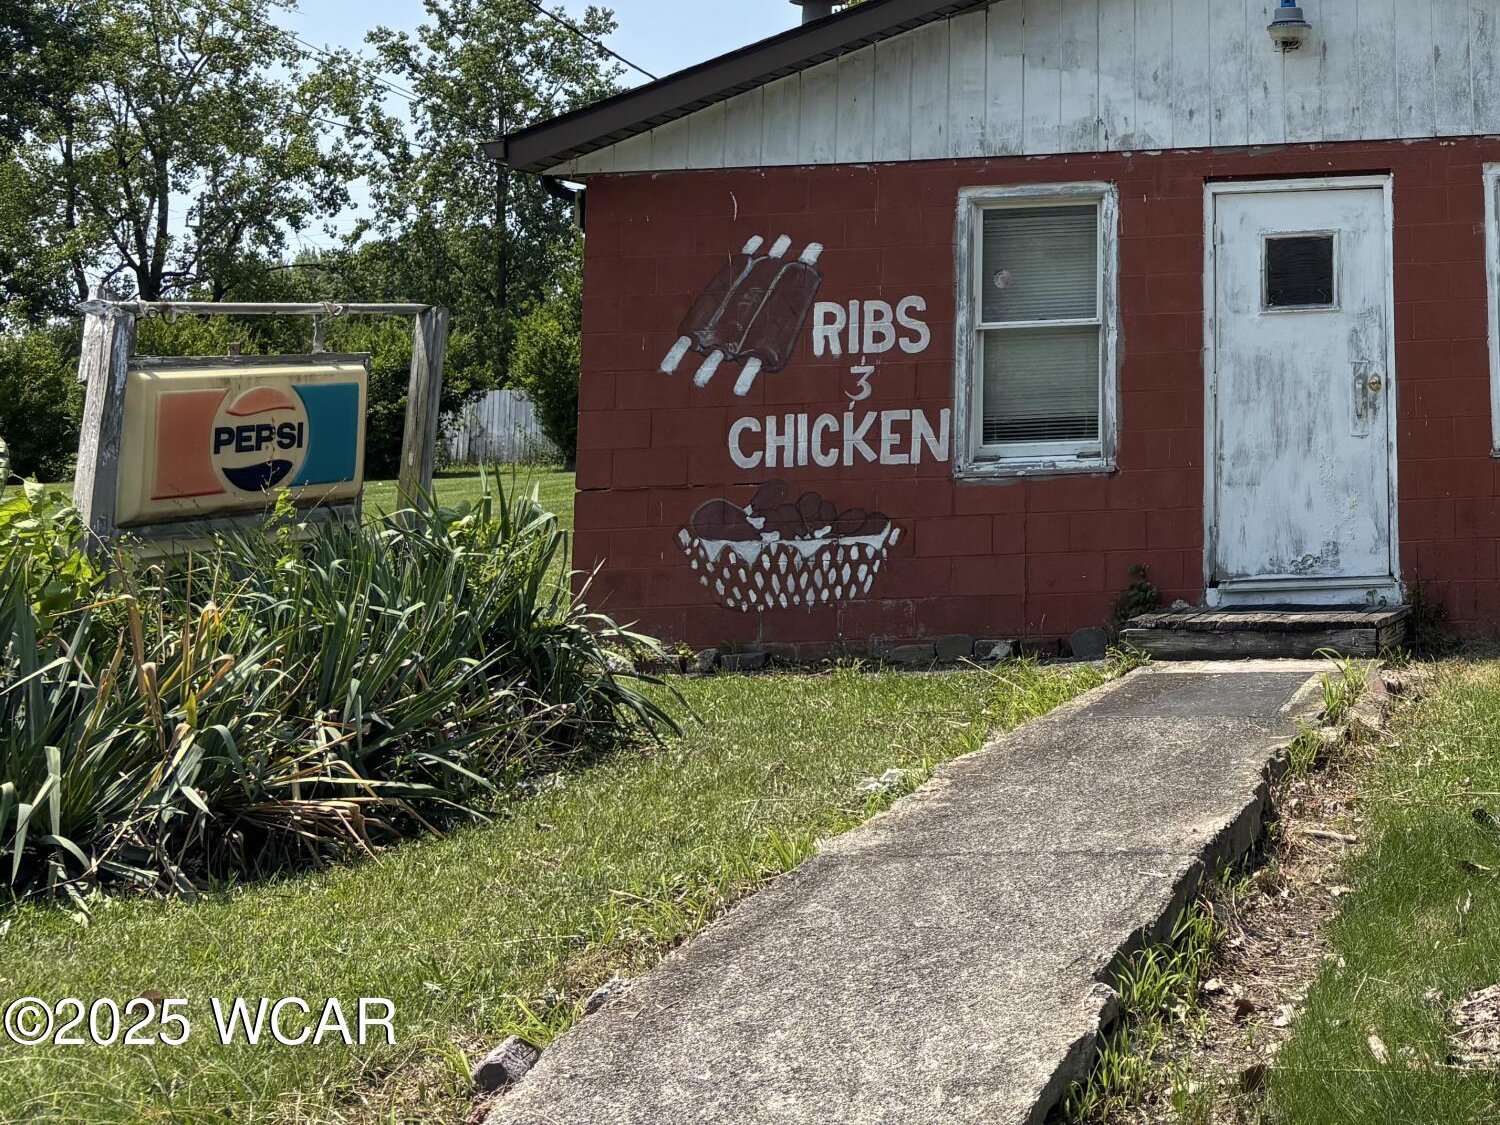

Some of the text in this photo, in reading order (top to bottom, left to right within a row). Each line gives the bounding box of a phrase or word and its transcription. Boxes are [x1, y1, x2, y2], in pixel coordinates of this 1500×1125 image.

[814, 296, 930, 357] RIBS
[214, 422, 304, 454] PEPSI
[730, 408, 950, 469] CHICKEN
